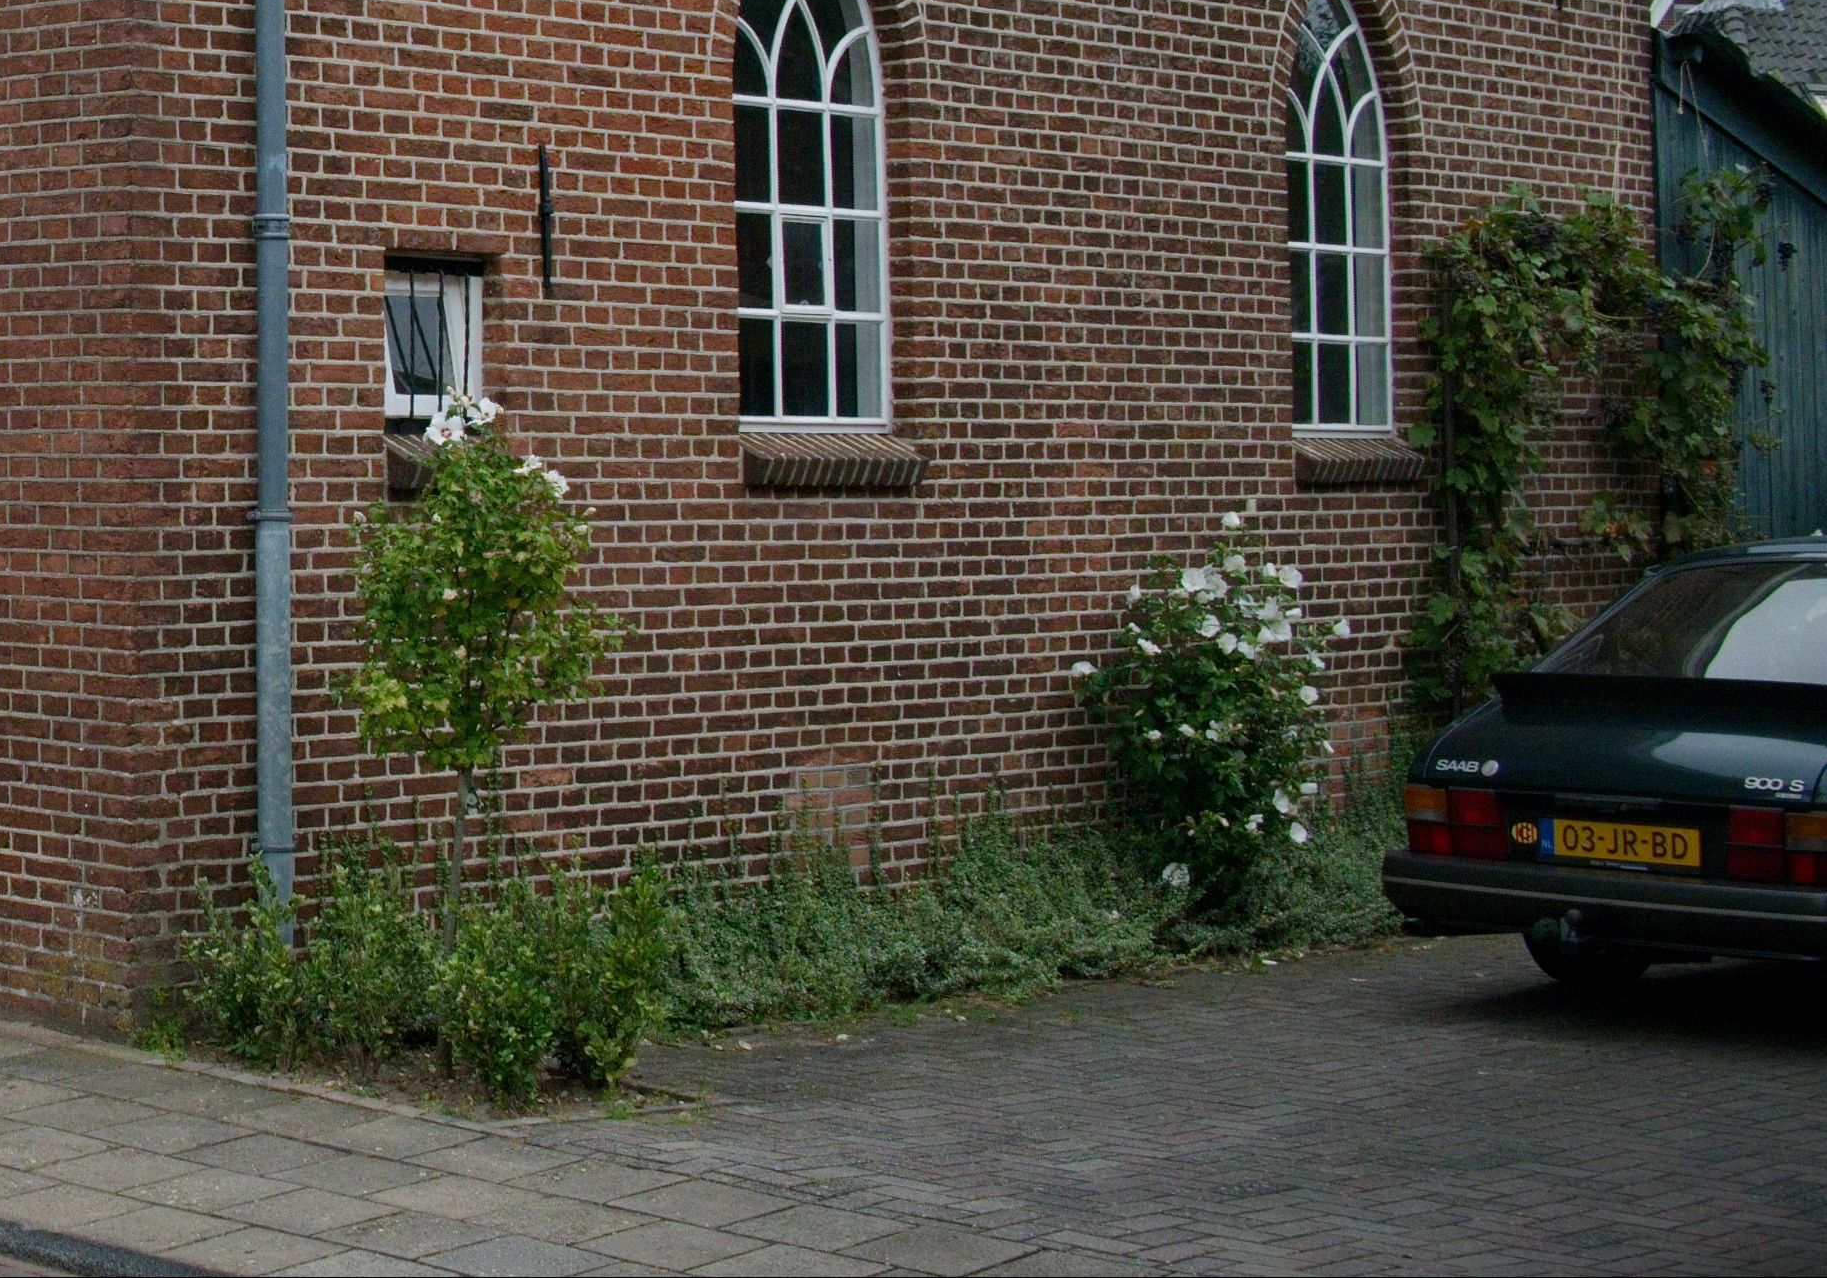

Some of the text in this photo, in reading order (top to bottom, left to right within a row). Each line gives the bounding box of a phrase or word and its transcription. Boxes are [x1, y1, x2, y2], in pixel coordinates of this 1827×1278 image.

[1436, 759, 1479, 772] SAAB
[1744, 777, 1805, 792] 900 S
[1562, 825, 1689, 860] 03-JR-BD
